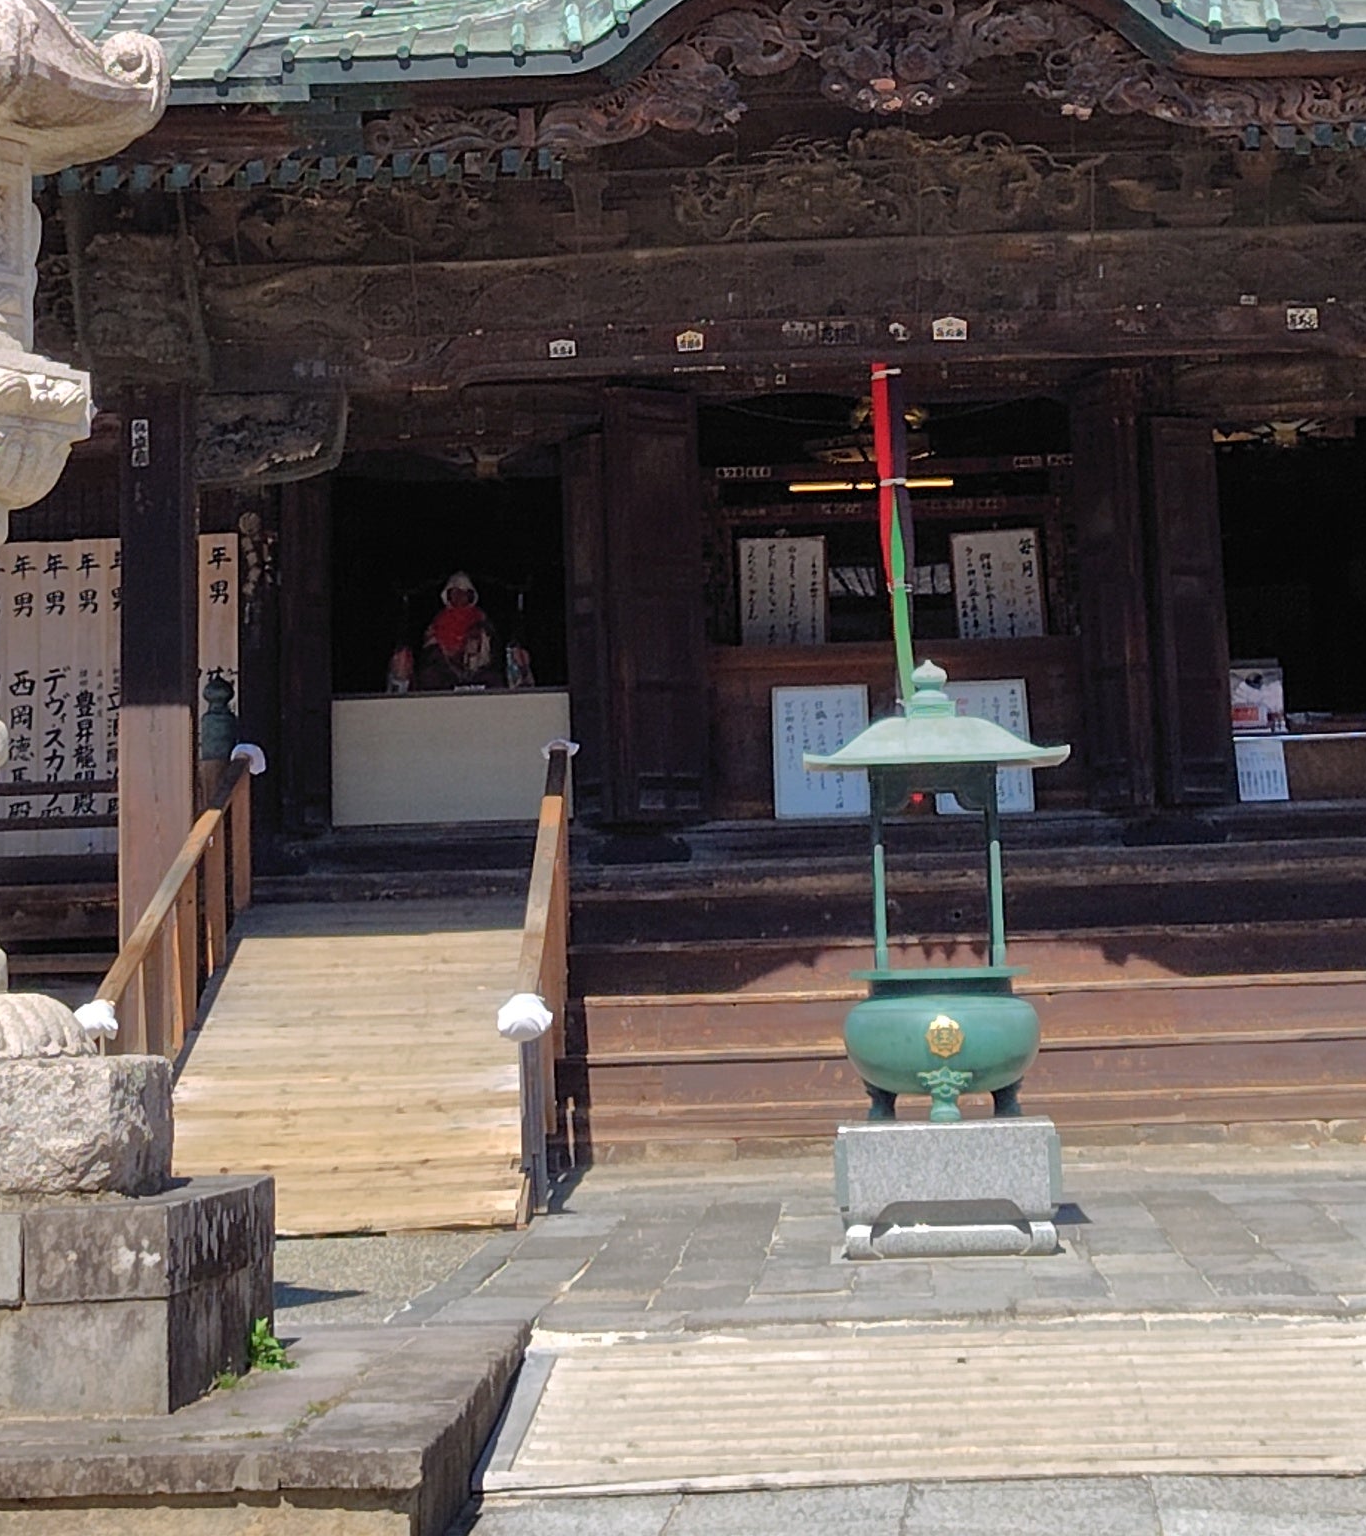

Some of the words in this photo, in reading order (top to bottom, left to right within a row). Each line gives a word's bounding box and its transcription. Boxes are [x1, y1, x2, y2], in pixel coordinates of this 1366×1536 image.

[10, 554, 37, 618] 年男
[42, 552, 69, 616] 年男
[75, 552, 101, 616] 年男
[208, 546, 232, 605] 年男
